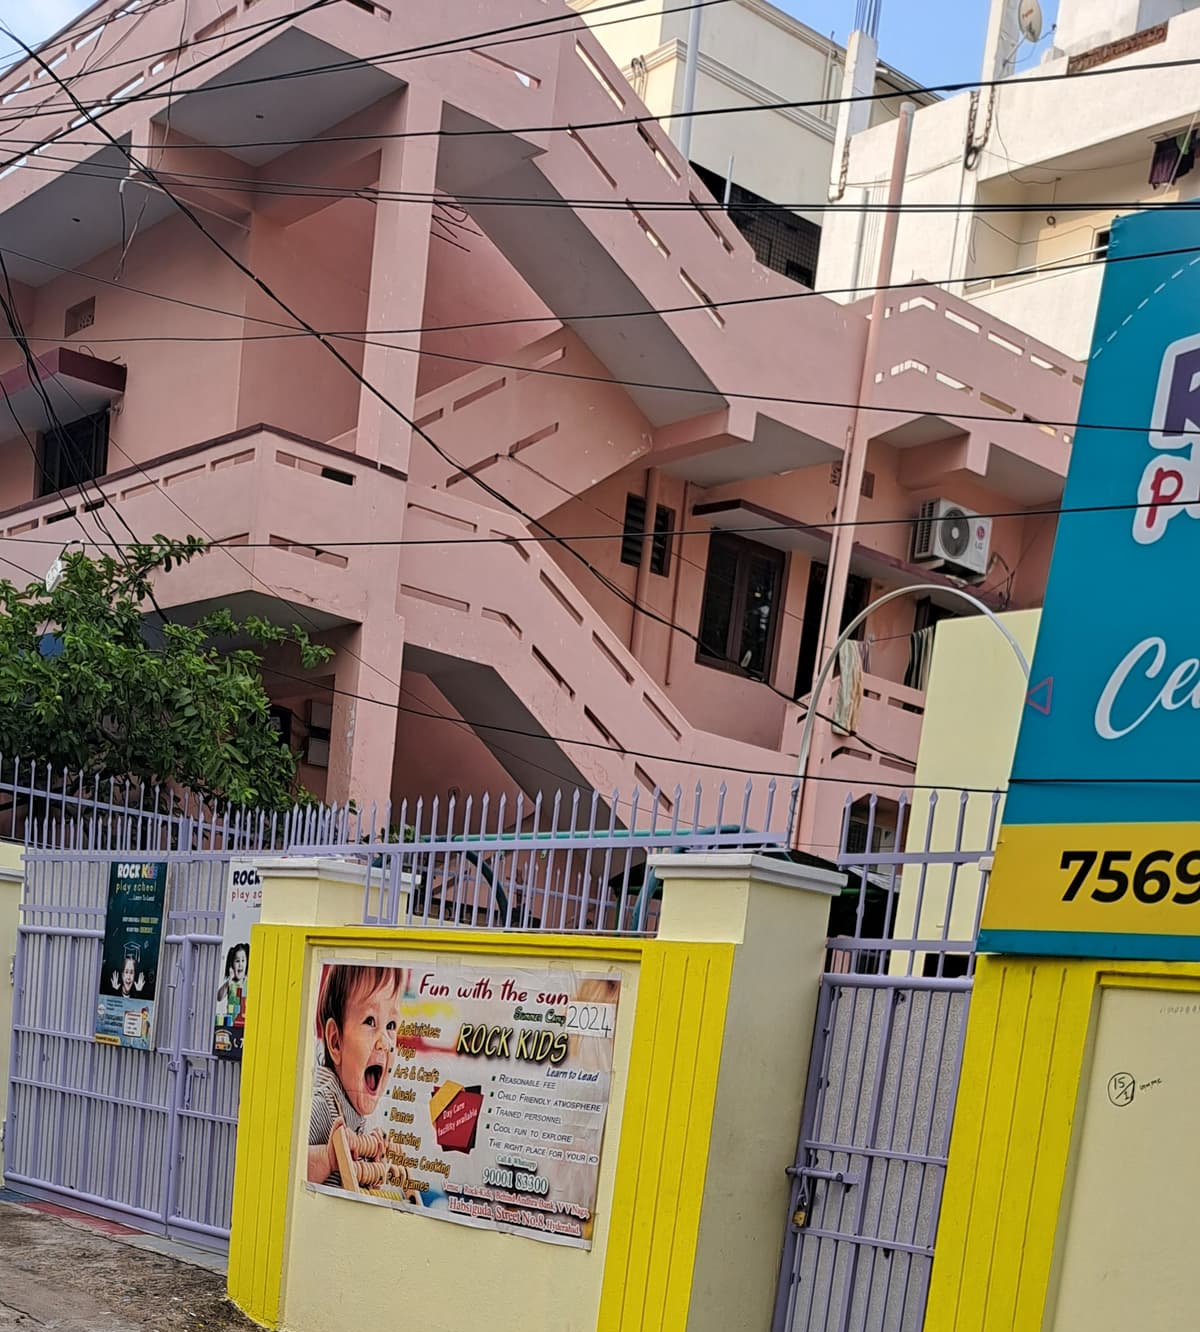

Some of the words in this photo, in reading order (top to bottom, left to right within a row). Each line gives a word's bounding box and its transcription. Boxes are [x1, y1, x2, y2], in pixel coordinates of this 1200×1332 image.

[117, 863, 141, 879] ROCK
[1060, 849, 1200, 905] 7569
[116, 880, 132, 895] play
[133, 881, 157, 893] school
[231, 888, 250, 902] play
[419, 974, 450, 997] Fun
[457, 978, 493, 1000] with
[500, 979, 528, 1002] the
[536, 992, 569, 1006] sun
[545, 1008, 566, 1027] Camp
[567, 1005, 612, 1037] 2024
[397, 1043, 416, 1061] Yoga
[456, 1022, 513, 1058] ROCK
[515, 1028, 569, 1063] KIDS
[393, 1064, 409, 1079] Art
[409, 1065, 416, 1081] &
[417, 1067, 440, 1083] Craft
[546, 1067, 568, 1078] Learn
[569, 1071, 576, 1080] to
[577, 1070, 599, 1082] Lead
[391, 1086, 417, 1103] Music
[389, 1107, 415, 1124] Dance
[389, 1129, 421, 1151] Painting
[419, 1155, 451, 1179] Cooking
[483, 1167, 513, 1188] 90001
[515, 1174, 548, 1194] 83300
[495, 1205, 521, 1224] Street
